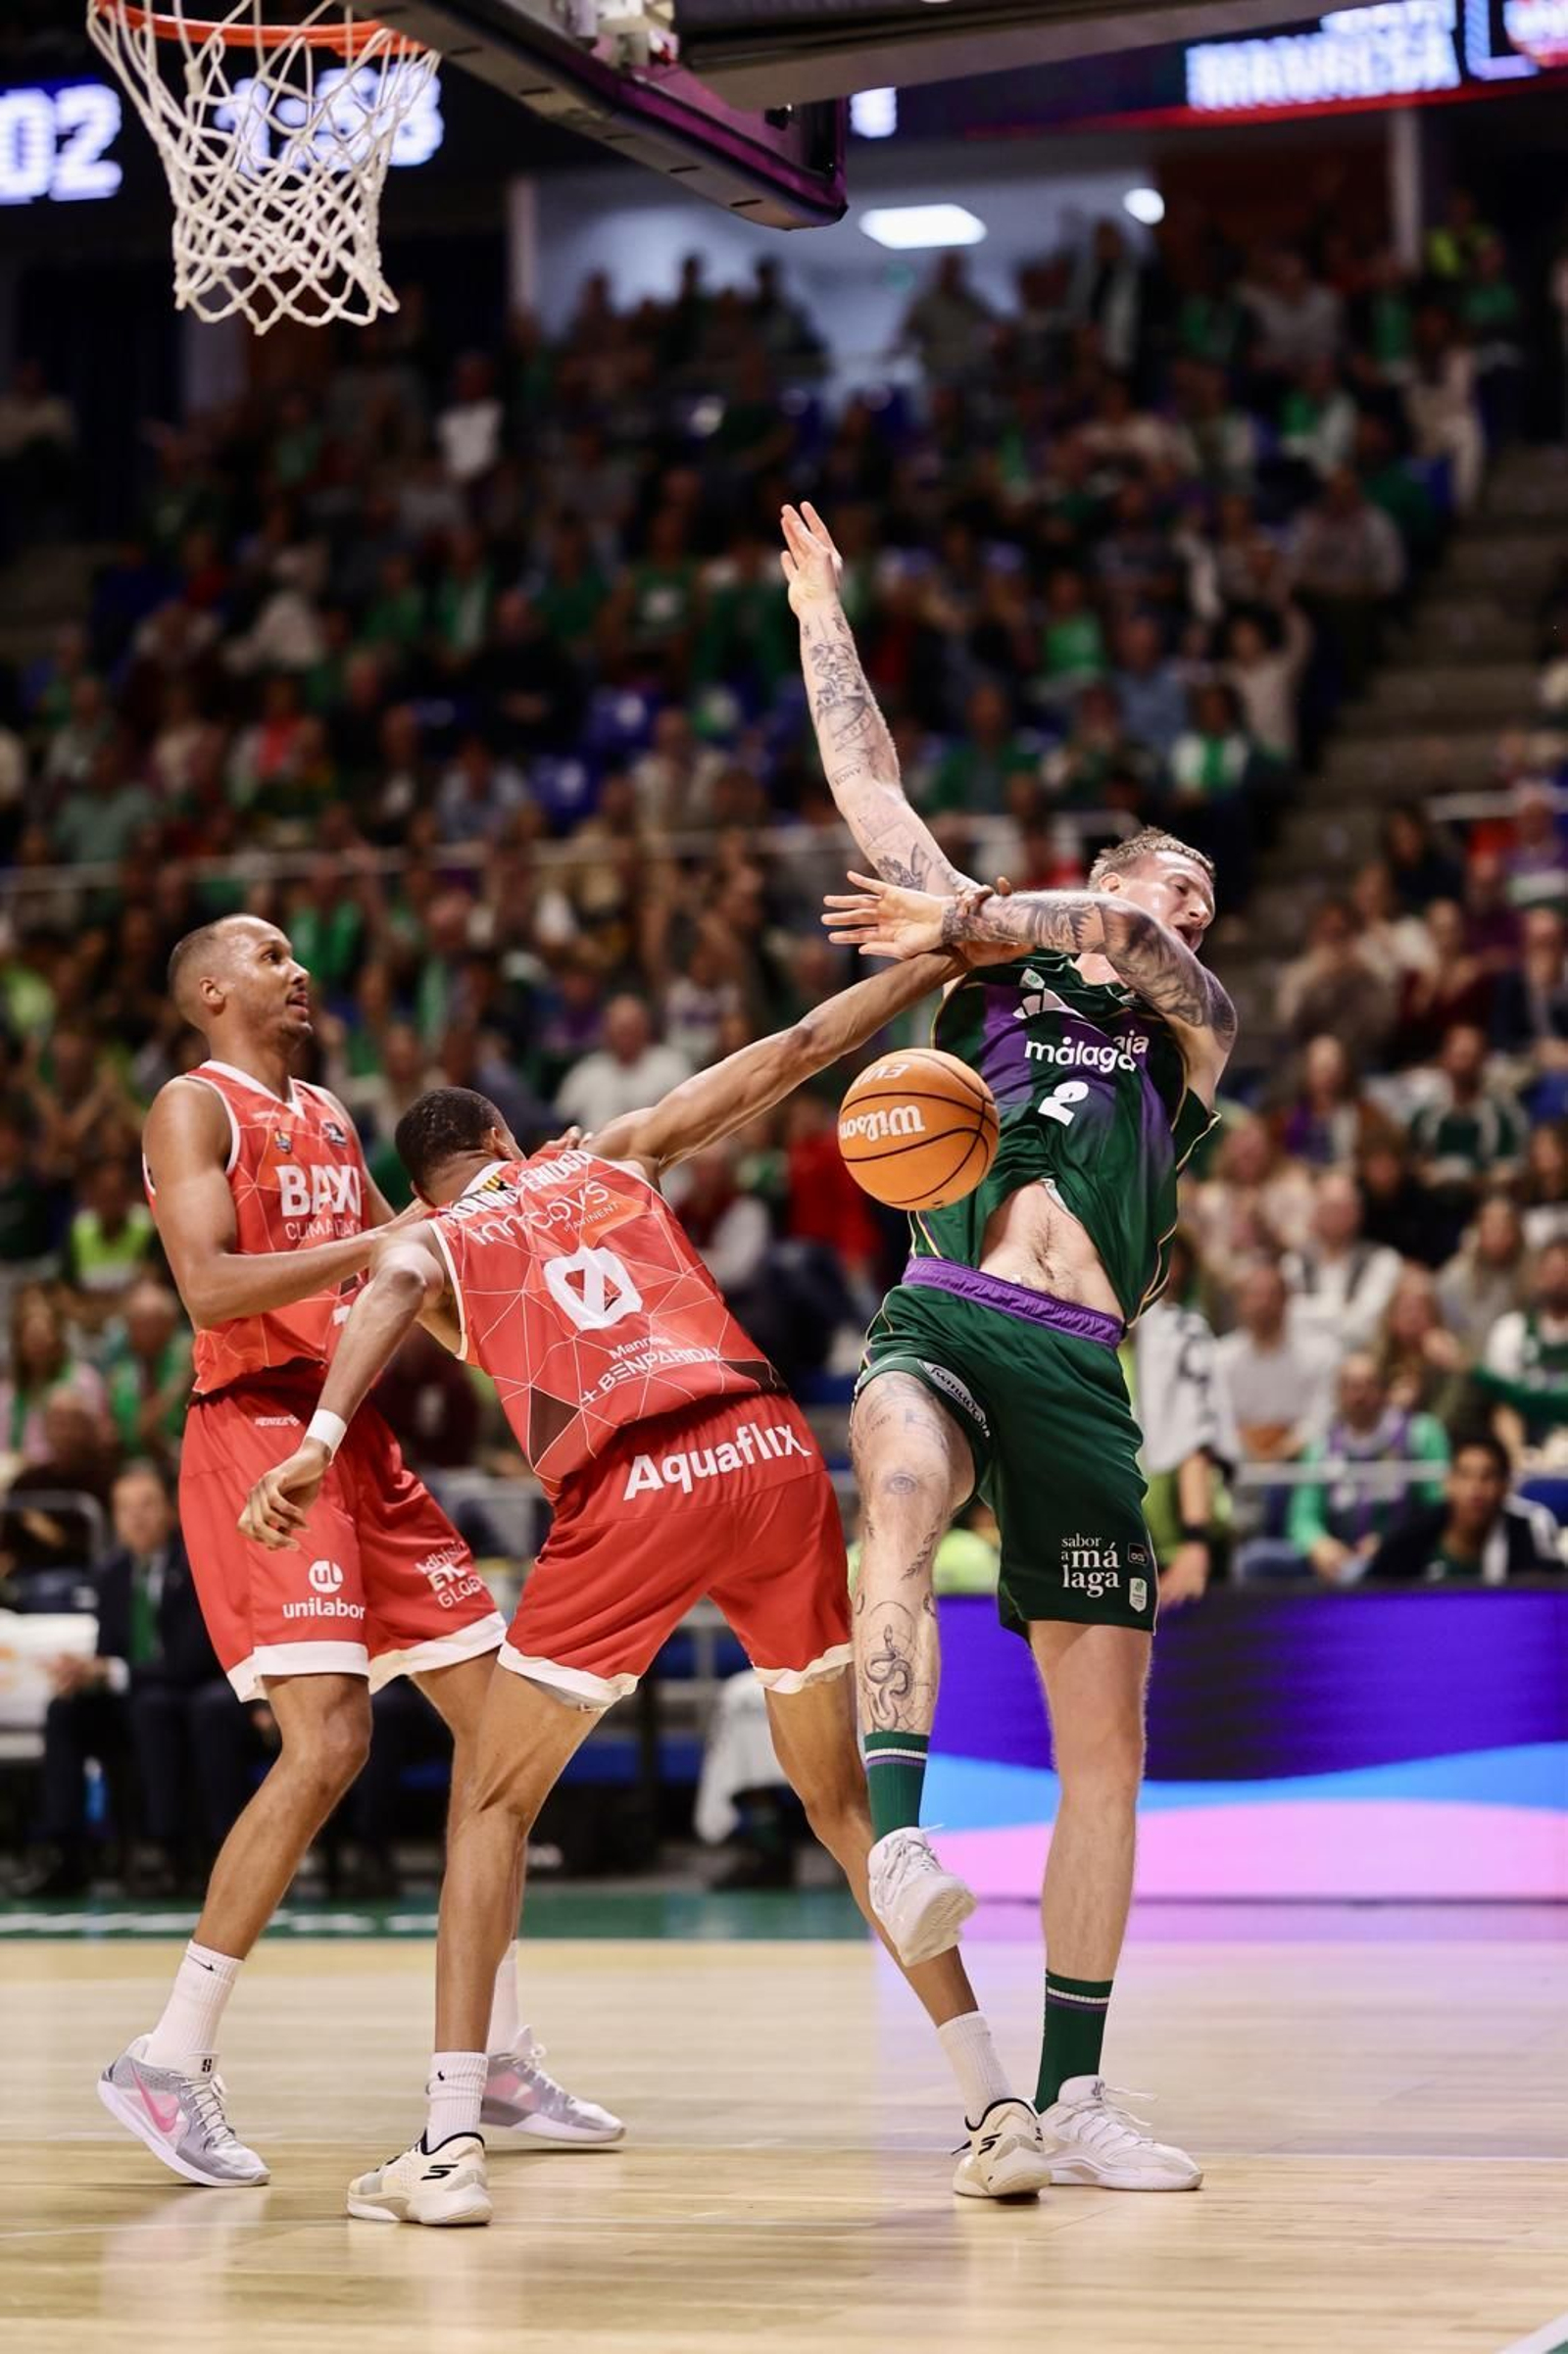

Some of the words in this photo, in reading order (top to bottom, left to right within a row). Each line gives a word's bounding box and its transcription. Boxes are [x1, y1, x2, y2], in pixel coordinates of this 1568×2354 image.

[1037, 1080, 1090, 1127] 2
[839, 1104, 926, 1142] Wilson
[274, 1164, 362, 1217] BAXI
[622, 1422, 812, 1501] Aquaflix
[1060, 1532, 1102, 1548] sabor
[1060, 1549, 1070, 1562] a
[1071, 1542, 1121, 1569] má
[1062, 1564, 1122, 1598] laga
[281, 1596, 367, 1621] unilabor
